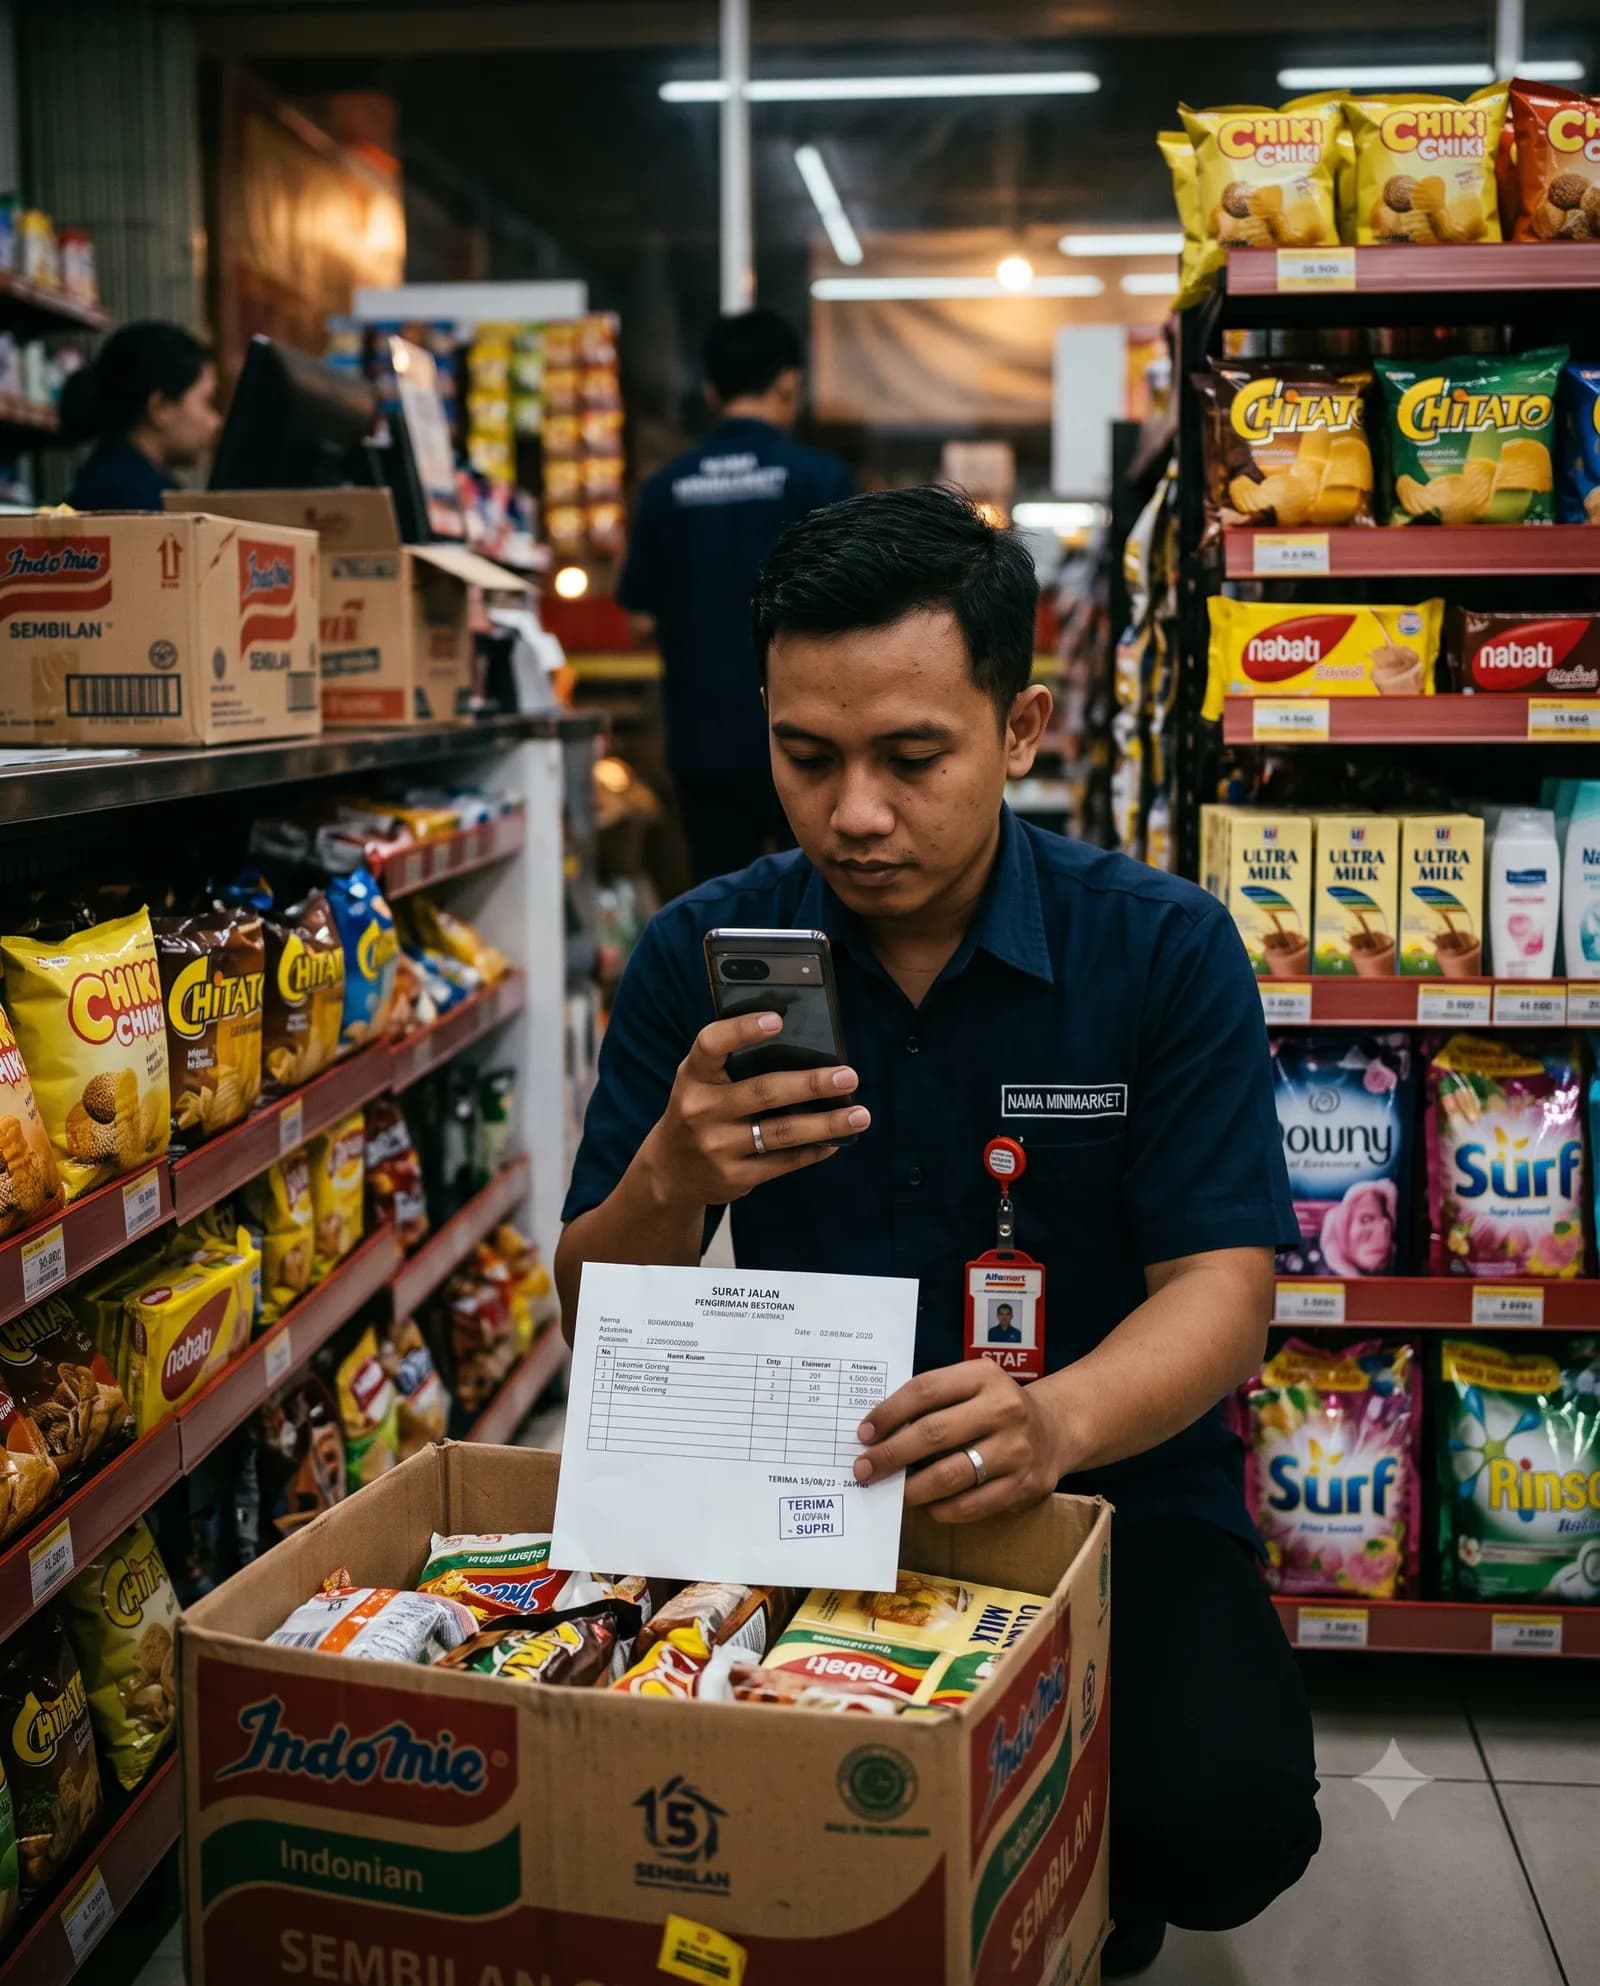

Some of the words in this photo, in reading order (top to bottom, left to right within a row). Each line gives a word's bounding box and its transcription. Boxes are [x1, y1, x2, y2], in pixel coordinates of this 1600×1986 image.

[1217, 118, 1325, 160] CHIKI
[1380, 110, 1488, 154] CHIKI
[1254, 144, 1322, 167] CHIKI
[1417, 137, 1485, 161] CHIKI
[10, 622, 102, 639] SEMBILAN
[1248, 636, 1320, 664] nabati
[1480, 642, 1553, 670] nabati
[1243, 848, 1298, 864] ULTRA
[1329, 848, 1385, 864] ULTRA
[1413, 848, 1470, 864] ULTRA
[1248, 865, 1293, 881] MILK
[1334, 865, 1379, 881] MILK
[1419, 865, 1464, 881] MILK
[1008, 1093, 1043, 1109] NAMA
[1046, 1092, 1121, 1110] MINIMARKET
[1279, 1124, 1392, 1166] owny
[1454, 1141, 1582, 1199] Surf
[985, 1273, 1026, 1282] Alfamart
[711, 1286, 745, 1297] SURAT
[747, 1288, 780, 1299] JALAN
[695, 1298, 748, 1309] PENGIRIMAN
[751, 1301, 795, 1311] BESTORAN
[795, 1328, 811, 1336] Date
[166, 1327, 213, 1378] nabati
[981, 1351, 1028, 1367] STAF
[645, 1363, 670, 1372] Goreng
[643, 1374, 669, 1384] Goreng
[641, 1385, 667, 1395] Goreng
[768, 1475, 798, 1484] TERIMA
[1268, 1455, 1398, 1517] Surf
[787, 1498, 834, 1510] TERIMA
[796, 1523, 834, 1535] SUPRI
[968, 1604, 1013, 1646] MILK
[806, 1654, 899, 1686] nabati
[279, 1838, 424, 1894] Indonian
[634, 1861, 731, 1889] SEMBILAN
[1009, 1788, 1093, 1973] SEMBILAN
